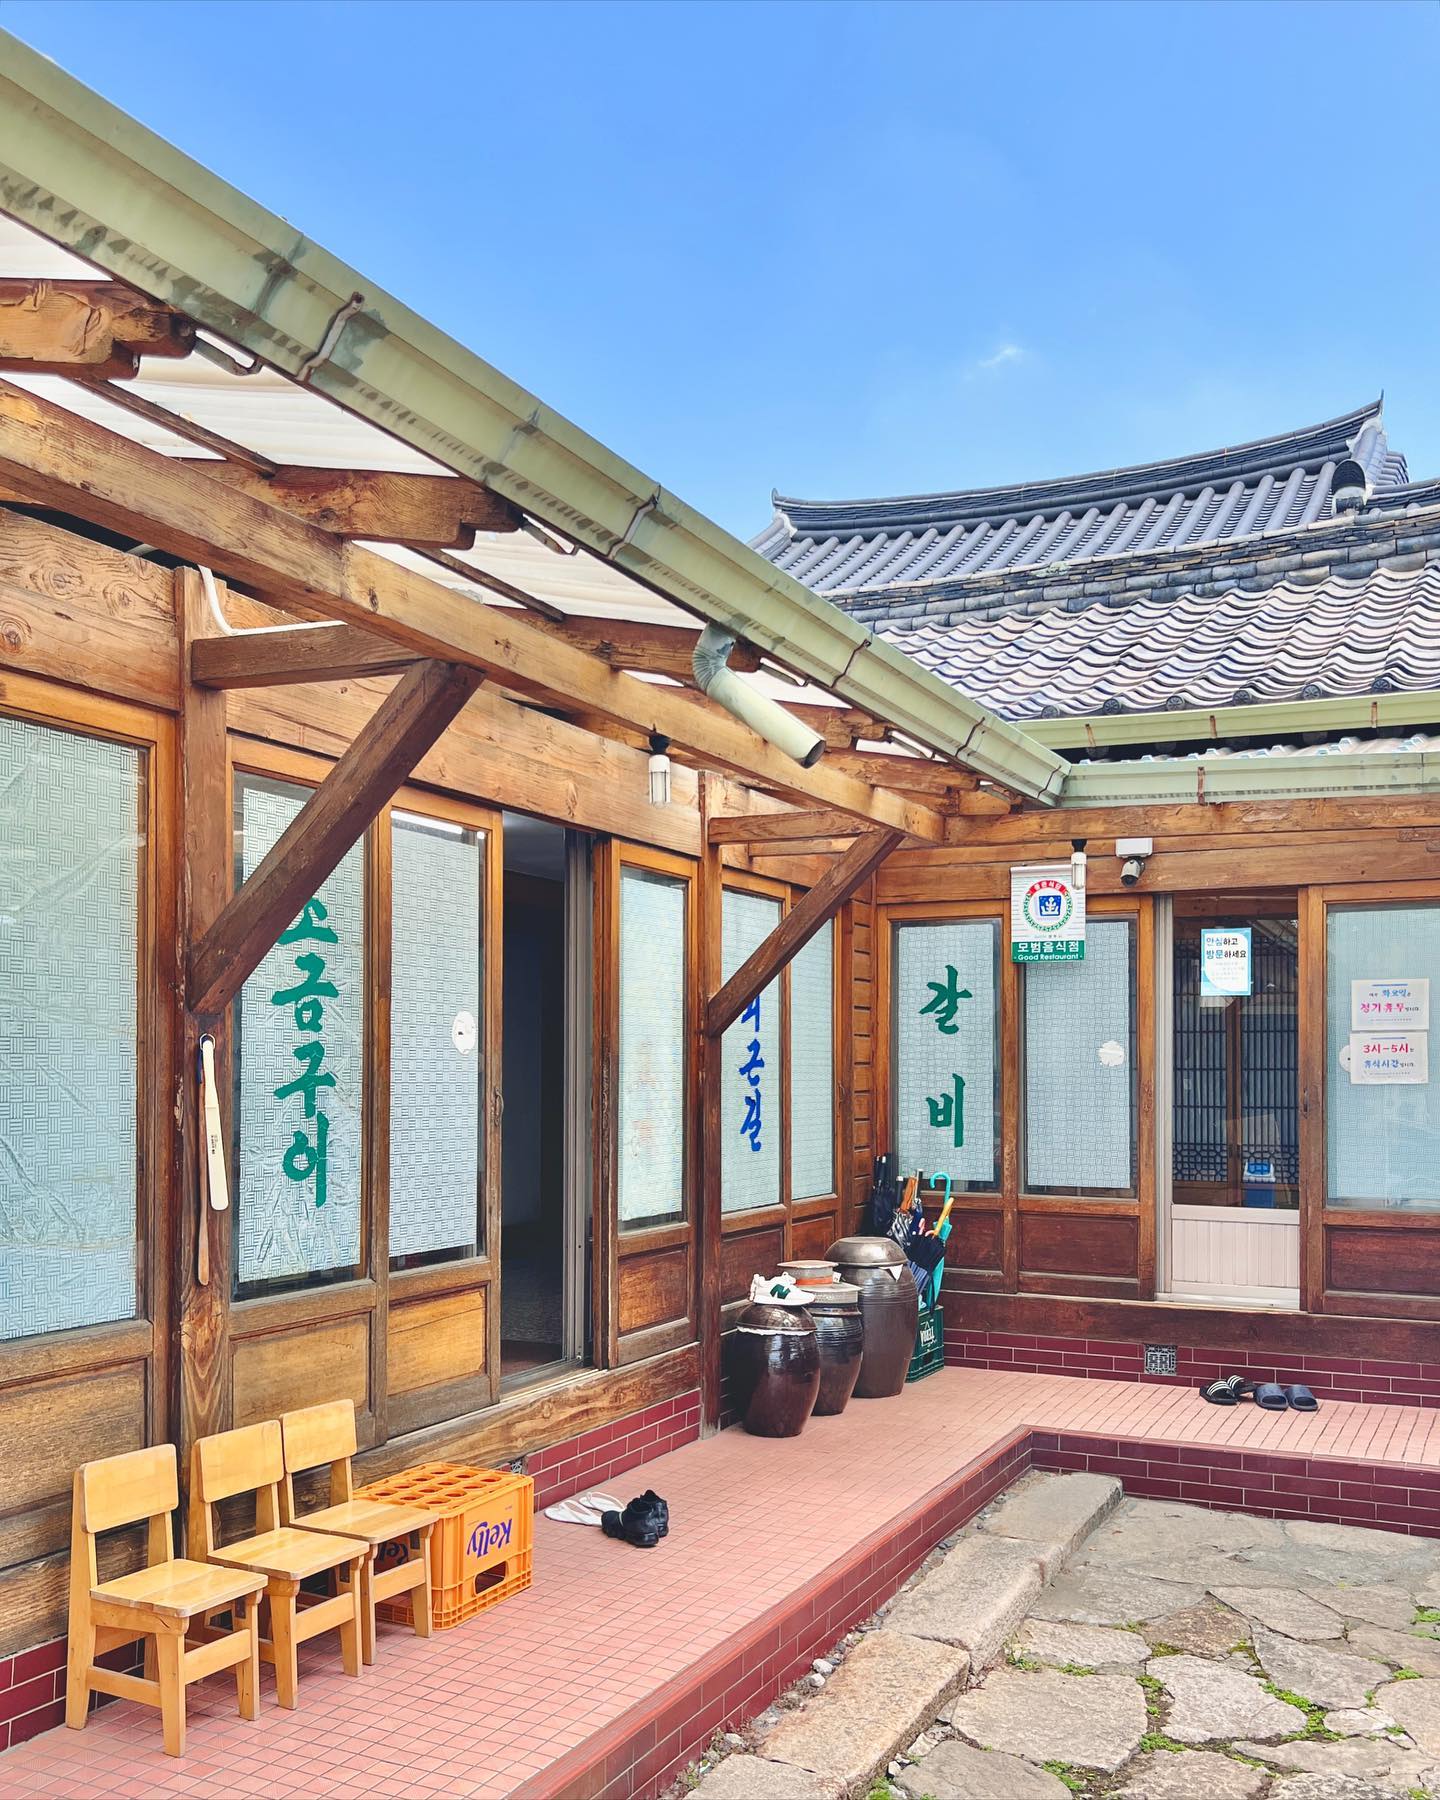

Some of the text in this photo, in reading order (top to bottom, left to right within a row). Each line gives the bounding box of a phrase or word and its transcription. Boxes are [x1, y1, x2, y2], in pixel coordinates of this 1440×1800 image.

[1018, 941, 1079, 953] 모범음식점
[1206, 937, 1239, 946] 안심하고
[1040, 953, 1079, 961] Restaurant
[1206, 949, 1247, 959] 방문하세요
[919, 964, 974, 1149] 갈비
[467, 1519, 513, 1558] Kelly
